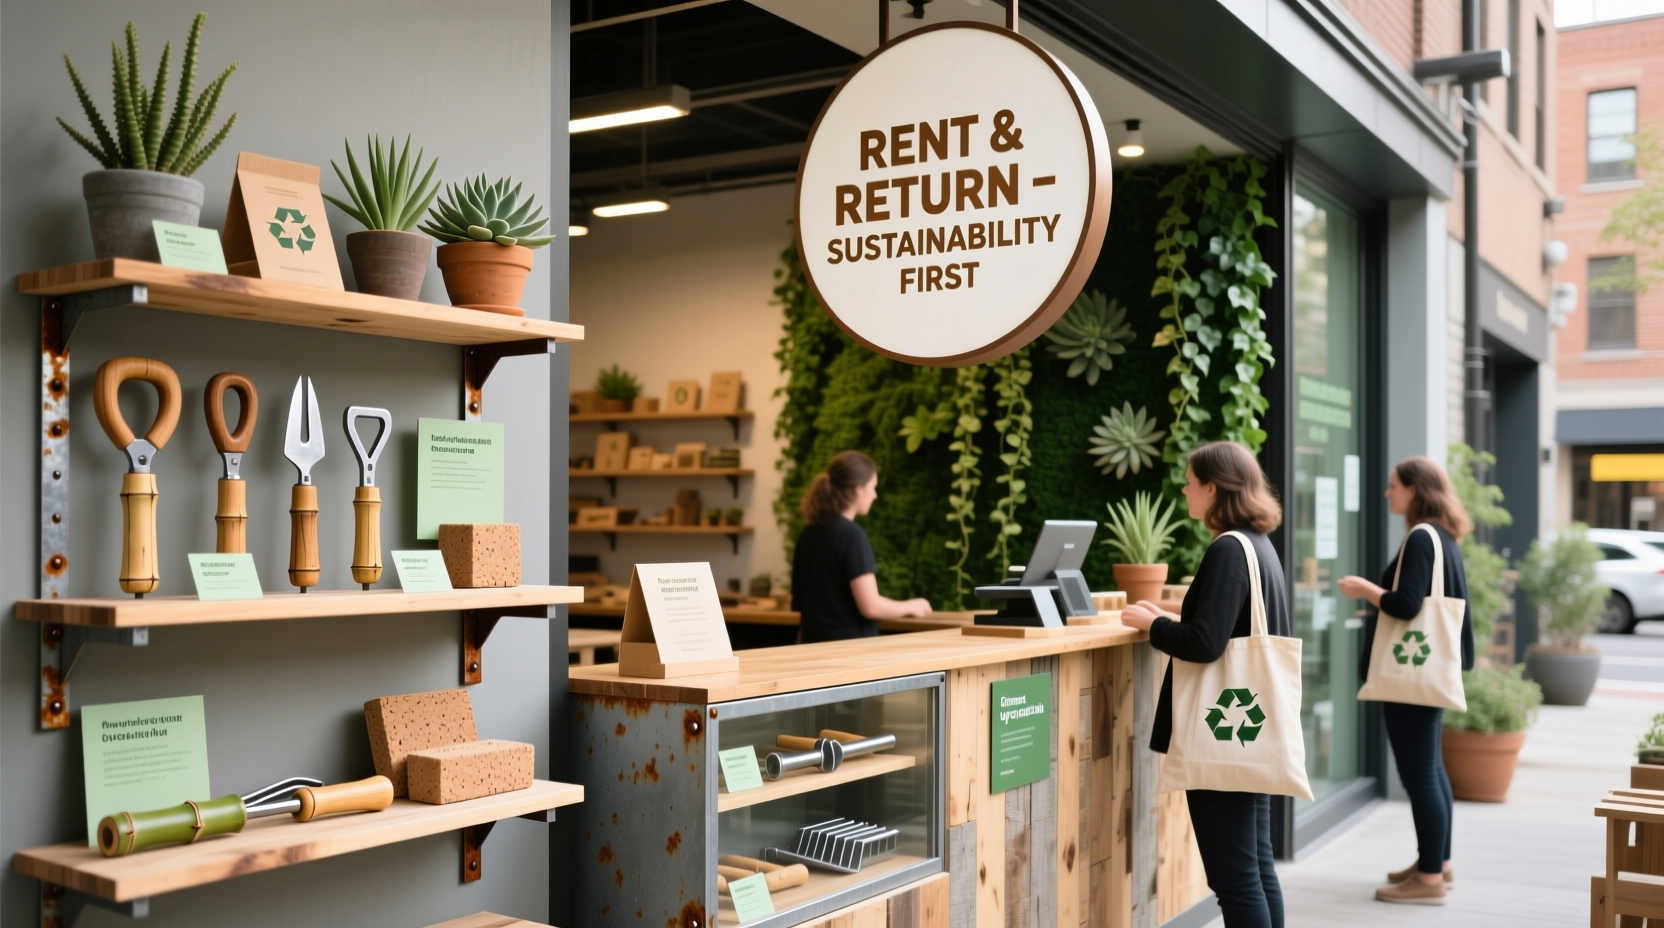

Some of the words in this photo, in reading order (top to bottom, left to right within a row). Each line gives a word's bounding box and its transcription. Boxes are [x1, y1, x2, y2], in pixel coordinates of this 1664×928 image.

[860, 114, 979, 171] RENT
[990, 109, 1024, 153] &
[836, 163, 1018, 227] RETURN
[826, 213, 1062, 265] SUSTAINABILITY
[900, 262, 980, 295] FIRST
